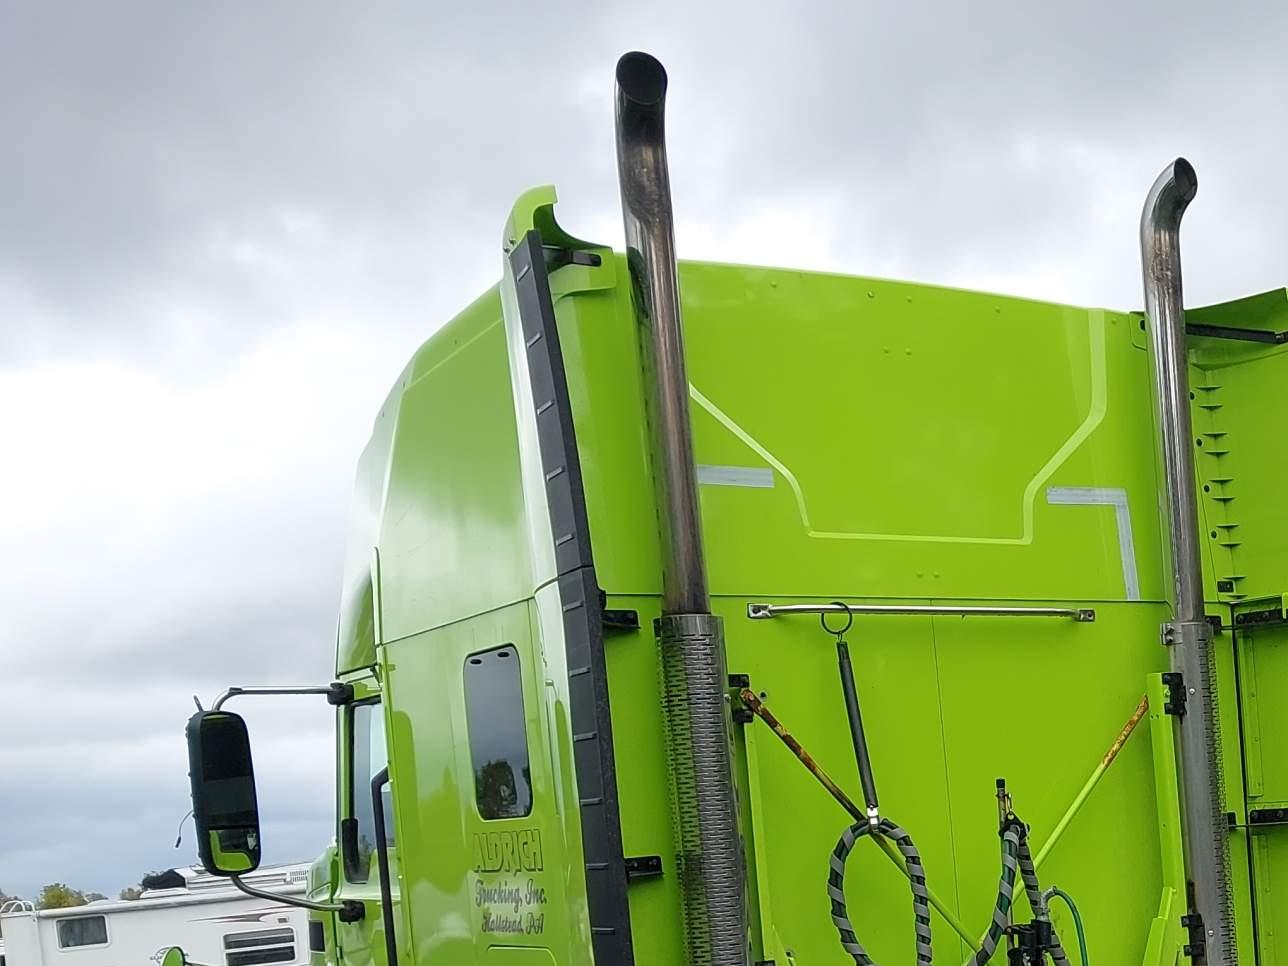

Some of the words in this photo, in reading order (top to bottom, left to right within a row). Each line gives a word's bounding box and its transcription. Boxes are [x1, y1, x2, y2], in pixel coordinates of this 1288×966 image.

[472, 828, 544, 877] ALDRICH
[475, 879, 523, 913] Trucking,
[525, 878, 547, 905] Inc.
